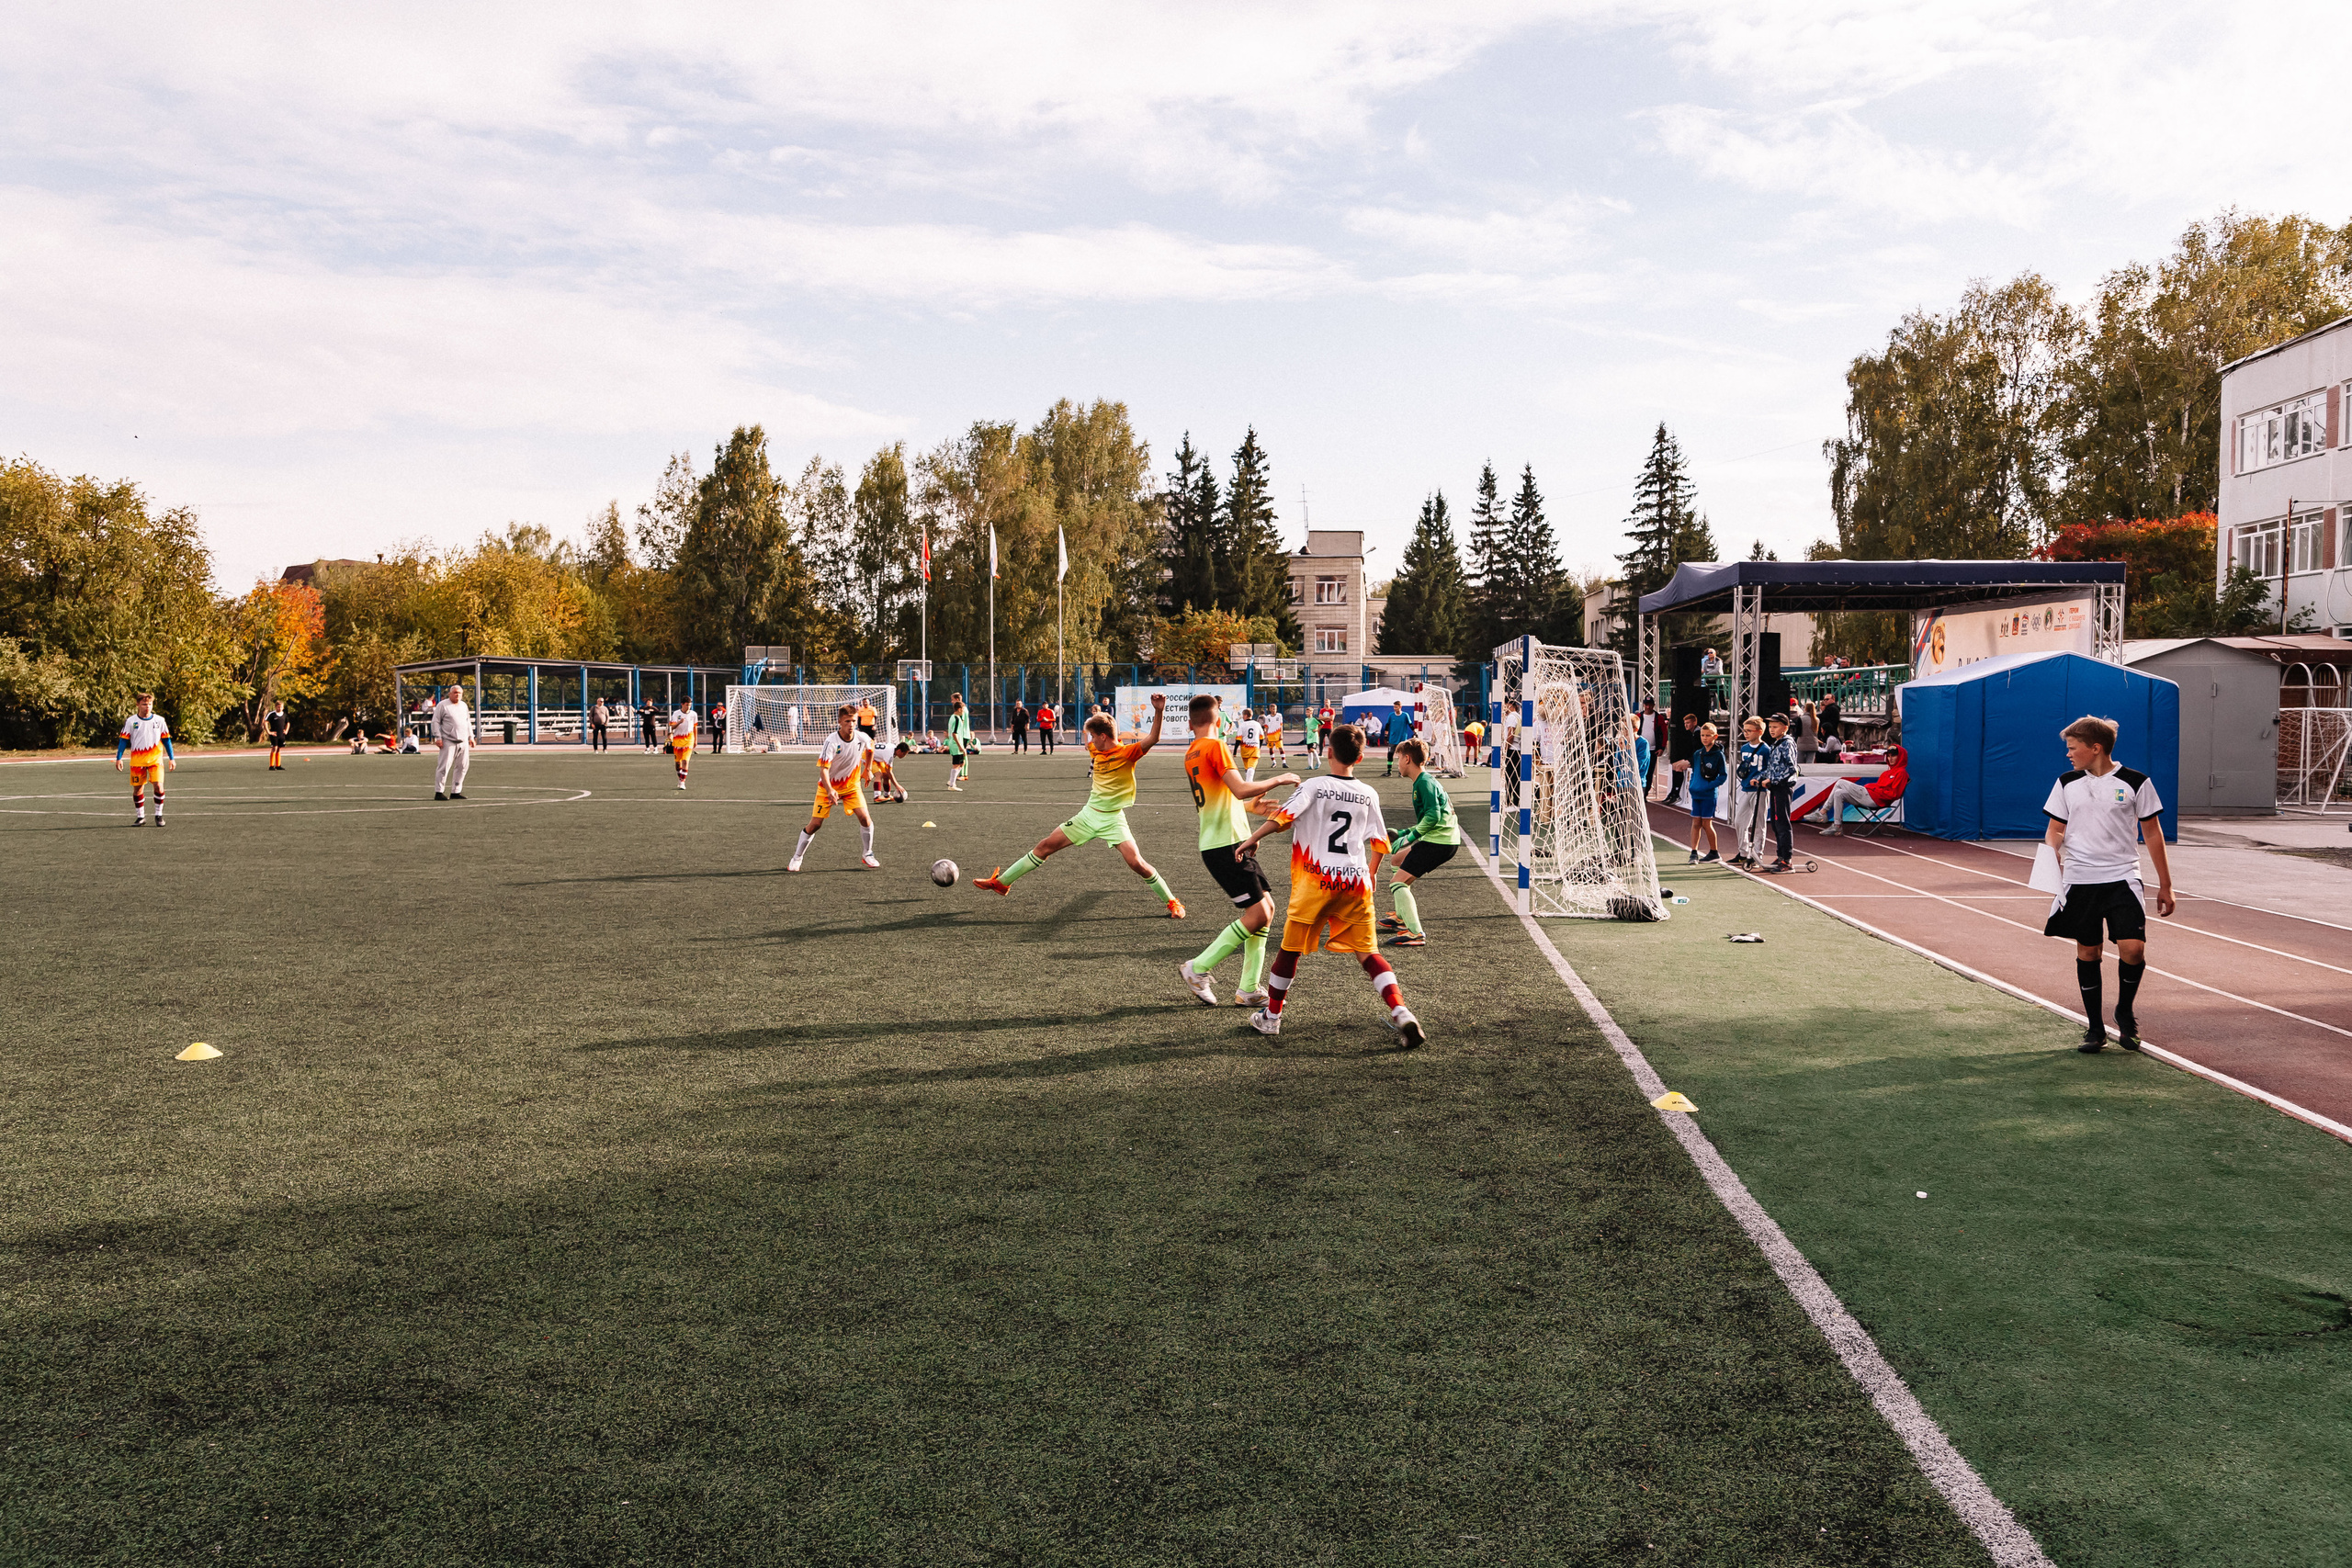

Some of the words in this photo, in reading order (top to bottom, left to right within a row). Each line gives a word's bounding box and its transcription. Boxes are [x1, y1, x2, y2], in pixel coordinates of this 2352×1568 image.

[1247, 728, 1254, 739] 6
[1317, 788, 1371, 807] БАРЫШЕВО
[817, 805, 823, 813] 7
[1328, 810, 1352, 854] 2
[1303, 862, 1367, 877] НОВОСИБИРС
[1319, 879, 1355, 891] РАЙОН
